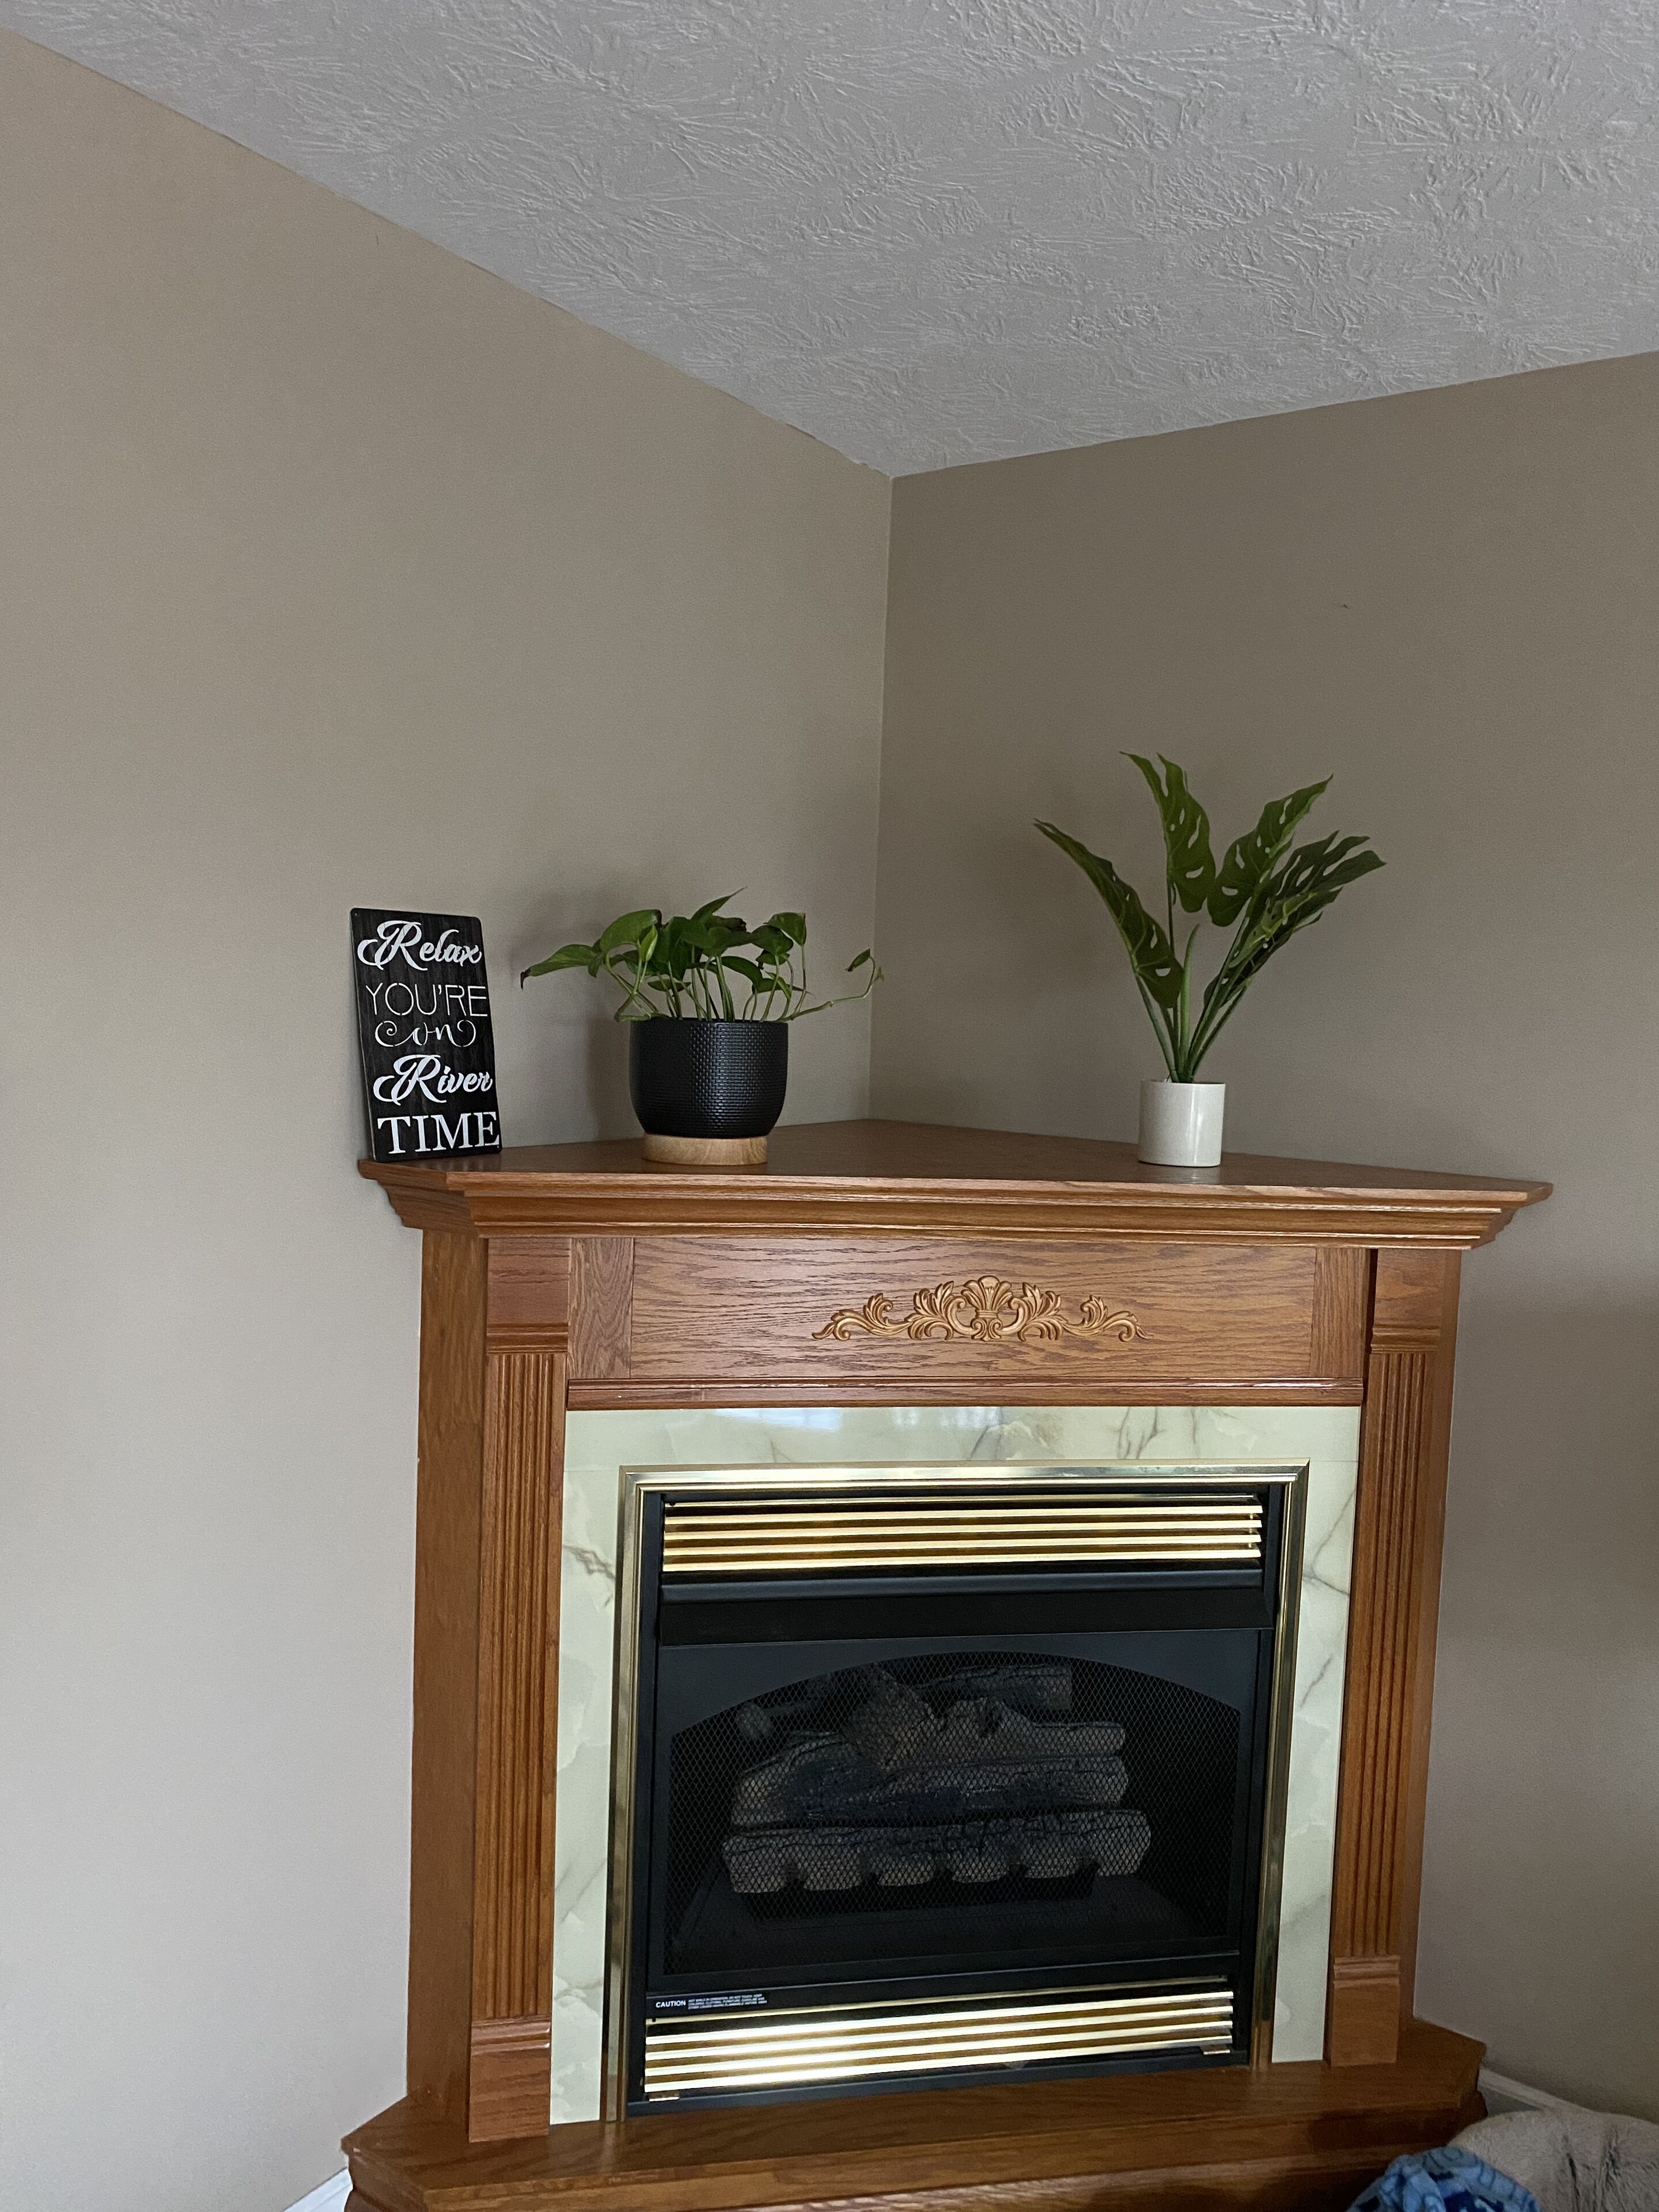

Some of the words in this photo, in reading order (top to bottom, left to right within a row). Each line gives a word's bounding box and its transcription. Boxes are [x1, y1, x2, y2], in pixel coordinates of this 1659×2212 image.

[357, 920, 482, 971] Relax
[366, 982, 488, 1017] YOU'RE
[375, 1020, 476, 1047] on
[373, 1054, 493, 1106] River
[377, 1111, 500, 1154] TIME
[656, 2000, 686, 2008] CAUTION
